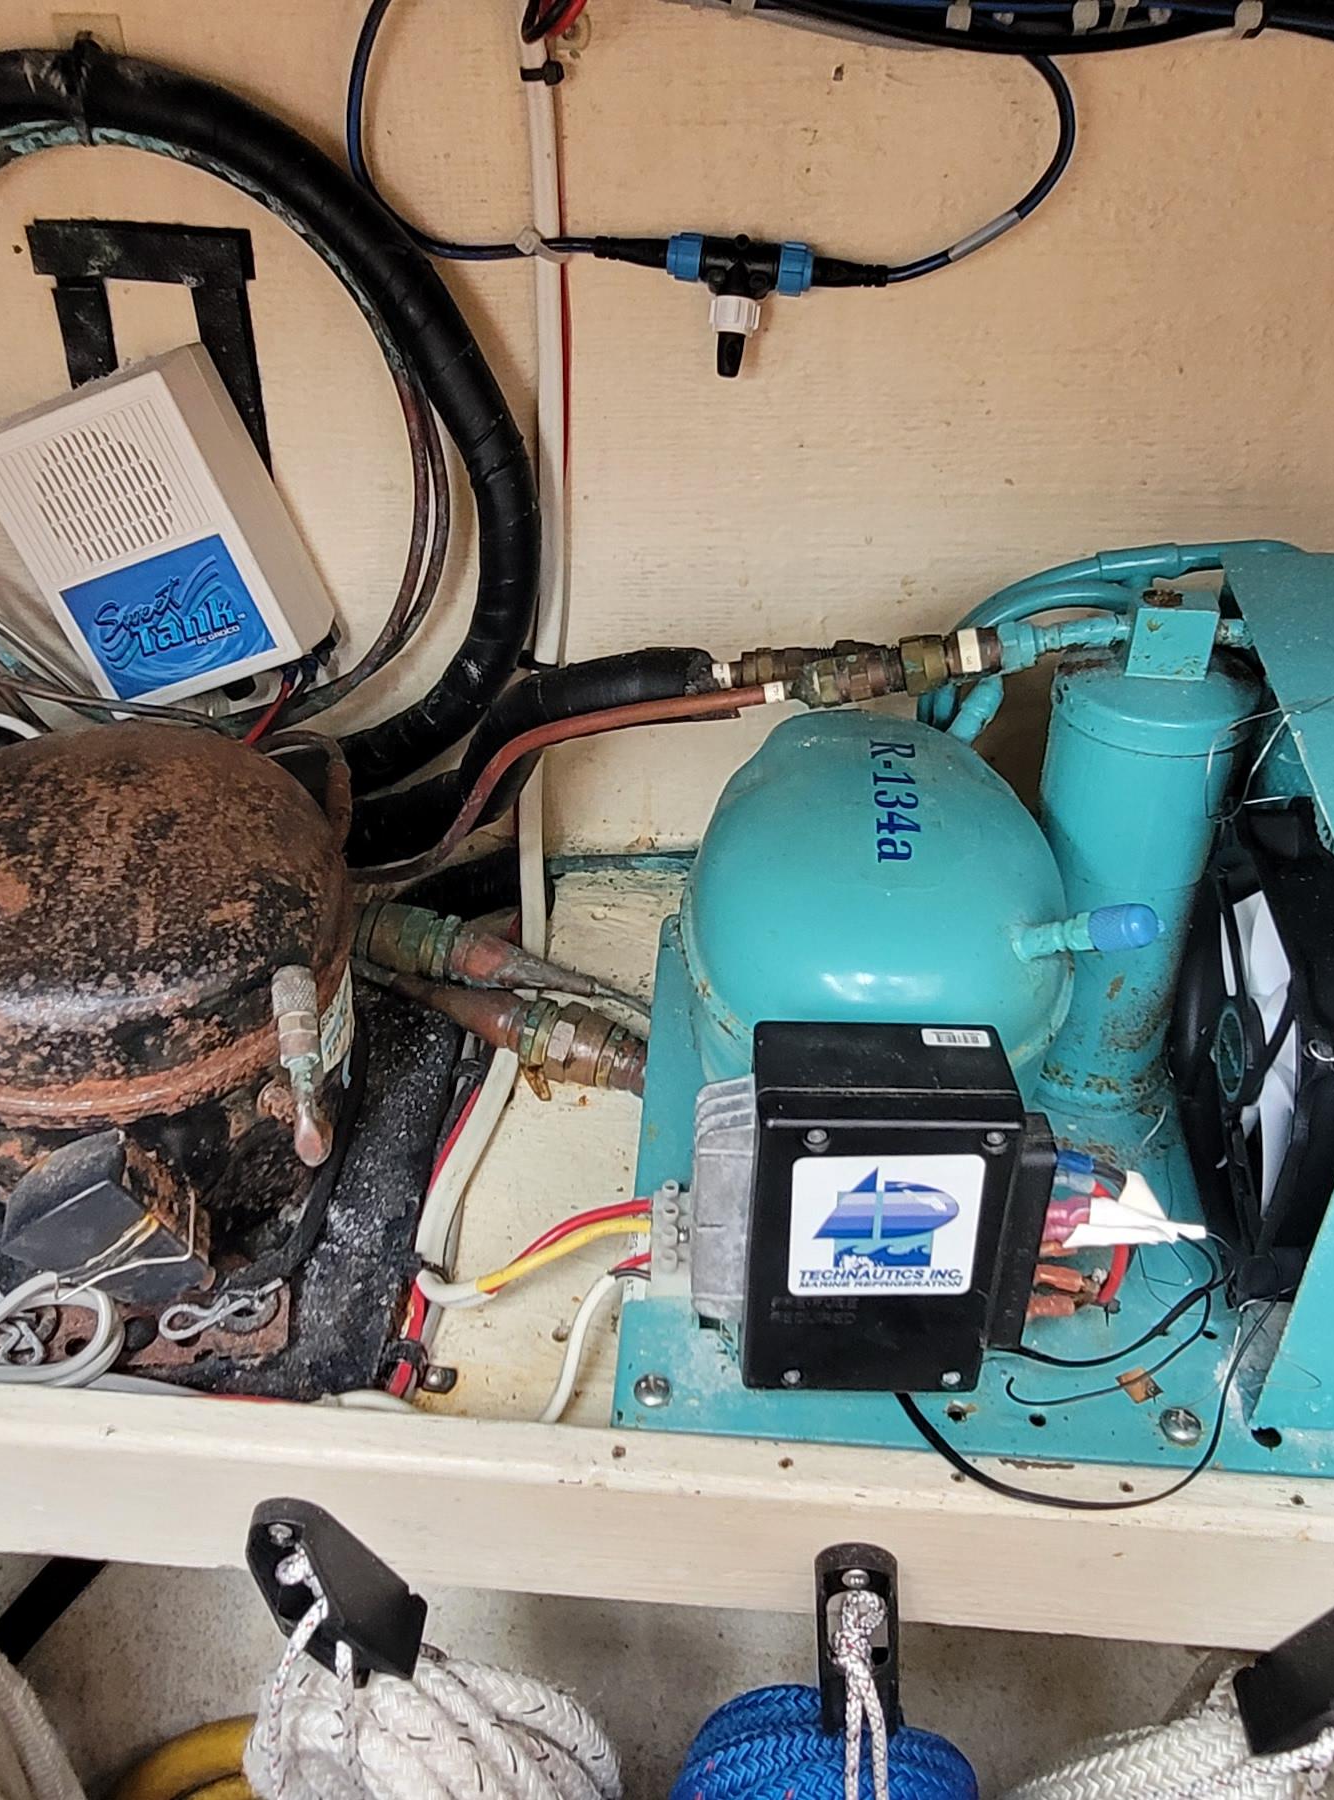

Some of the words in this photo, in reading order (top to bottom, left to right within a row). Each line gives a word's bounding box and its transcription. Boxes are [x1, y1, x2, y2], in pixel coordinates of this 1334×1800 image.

[94, 578, 181, 643] Sweet
[130, 598, 237, 657] Tank
[870, 740, 921, 863] R-134a
[799, 1269, 924, 1281] TECHNAUTICS
